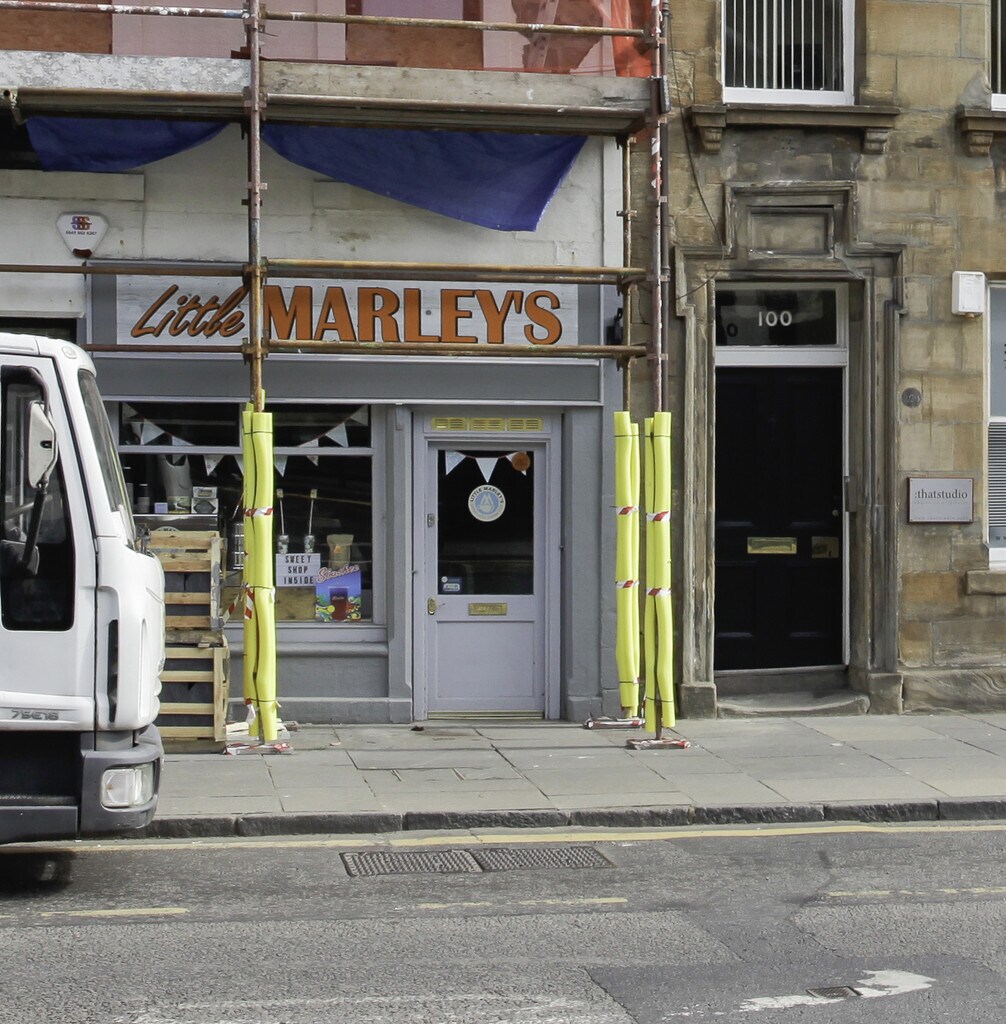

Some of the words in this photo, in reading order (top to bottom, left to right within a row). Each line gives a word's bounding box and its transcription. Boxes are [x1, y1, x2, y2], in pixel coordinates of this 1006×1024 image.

[130, 284, 250, 338] Little
[262, 284, 562, 346] MARLEY'S
[758, 310, 793, 327] 100
[914, 488, 968, 499] :thatstudio
[285, 555, 312, 564] SWEET
[288, 565, 308, 574] SHOP
